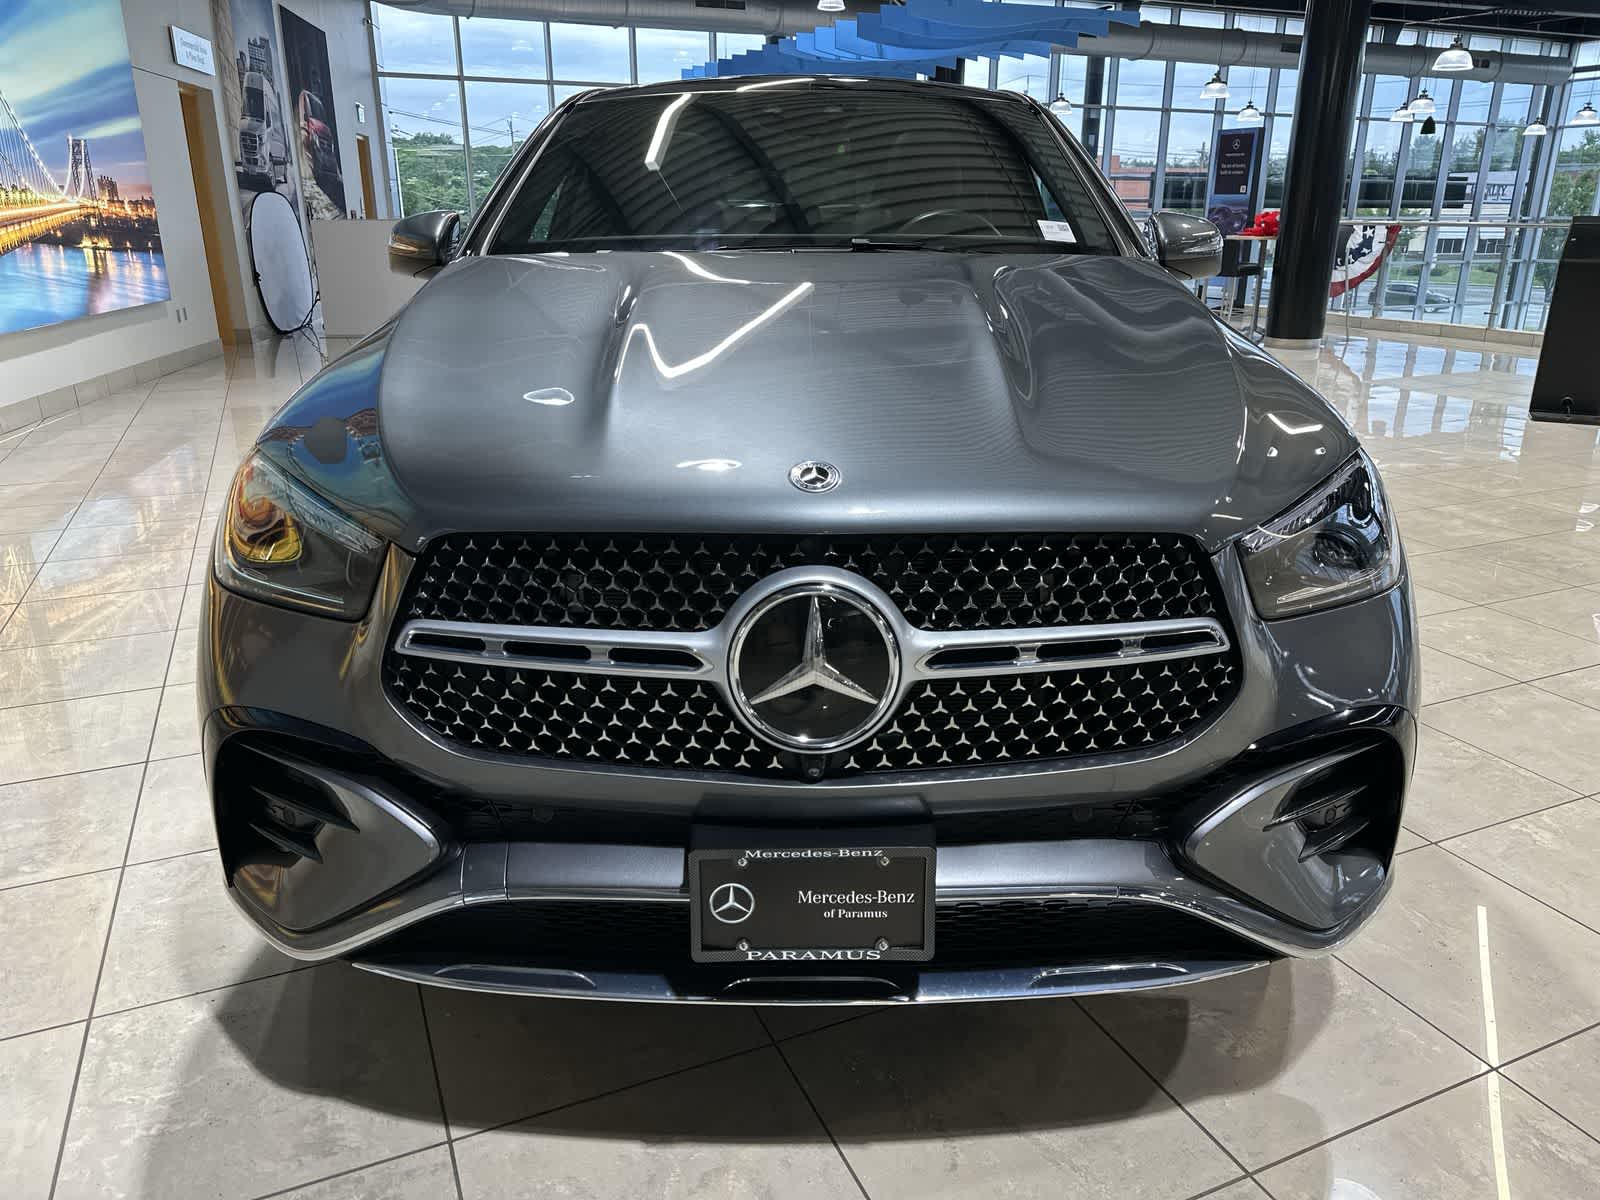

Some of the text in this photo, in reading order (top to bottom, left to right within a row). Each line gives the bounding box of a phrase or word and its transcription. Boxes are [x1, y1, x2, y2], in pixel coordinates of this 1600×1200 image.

[744, 849, 884, 858] Mercedes-Benz
[797, 889, 915, 905] Mercedes-Benz
[823, 908, 888, 919] of Paramus
[746, 949, 882, 961] PARAMUS
